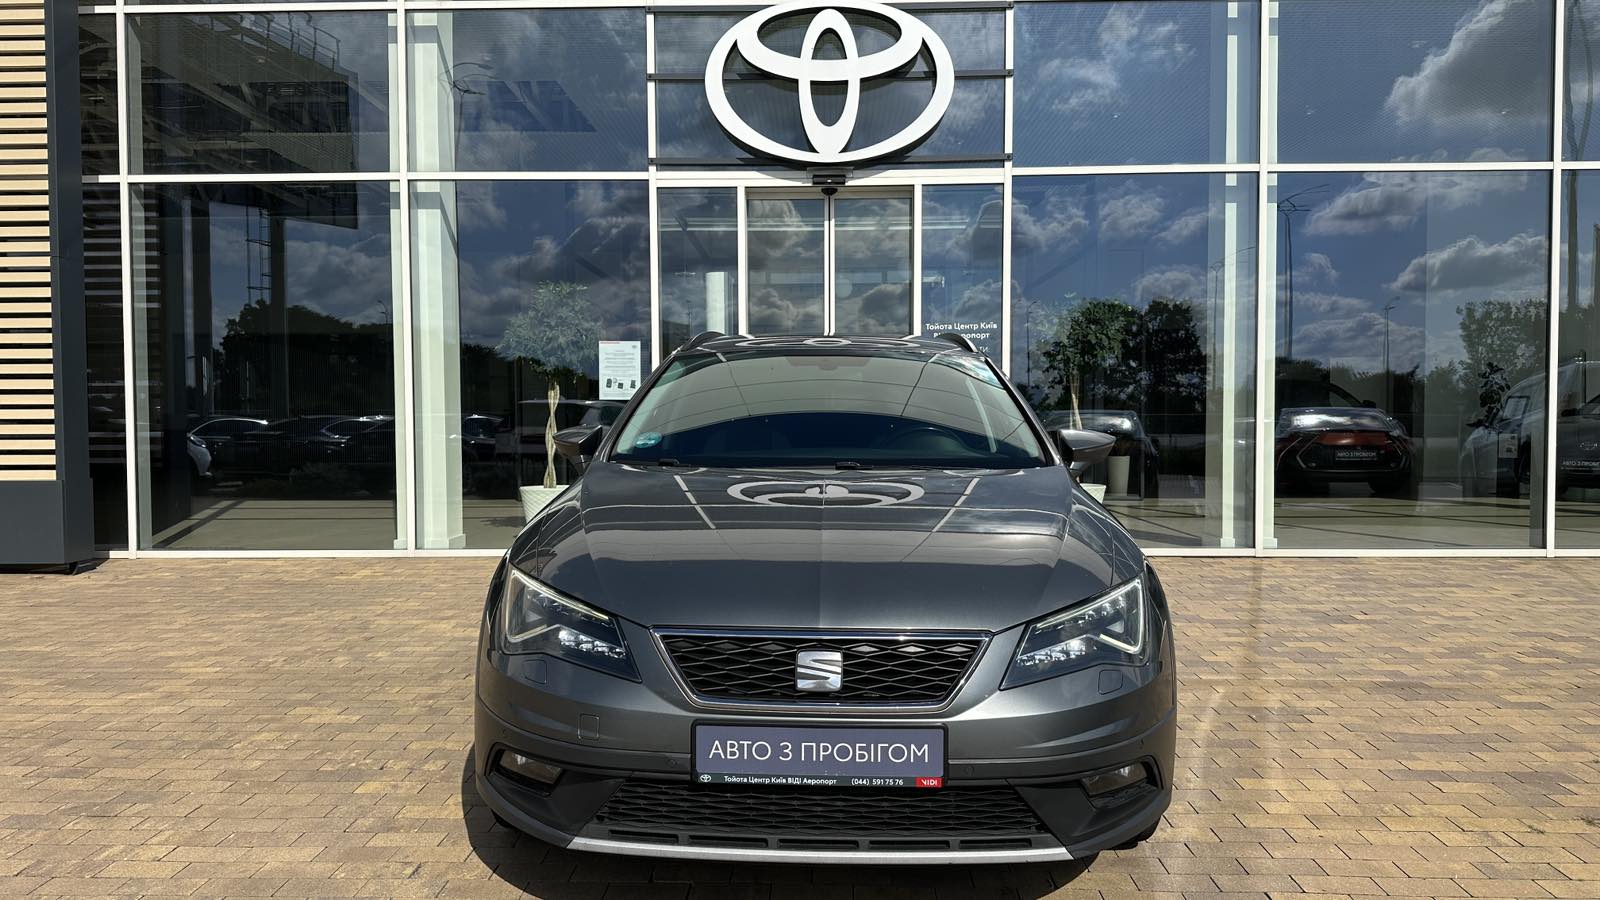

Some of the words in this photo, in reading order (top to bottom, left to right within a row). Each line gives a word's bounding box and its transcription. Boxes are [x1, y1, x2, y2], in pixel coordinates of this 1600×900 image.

[954, 322, 978, 331] Центр
[708, 739, 772, 761] АВТО
[779, 741, 793, 761] З
[801, 742, 929, 763] ПРОБІГОМ
[724, 775, 748, 783] Тойота
[748, 776, 770, 785] Центр
[771, 776, 786, 784] Київ
[851, 778, 869, 786] (044)
[872, 778, 884, 786] 591
